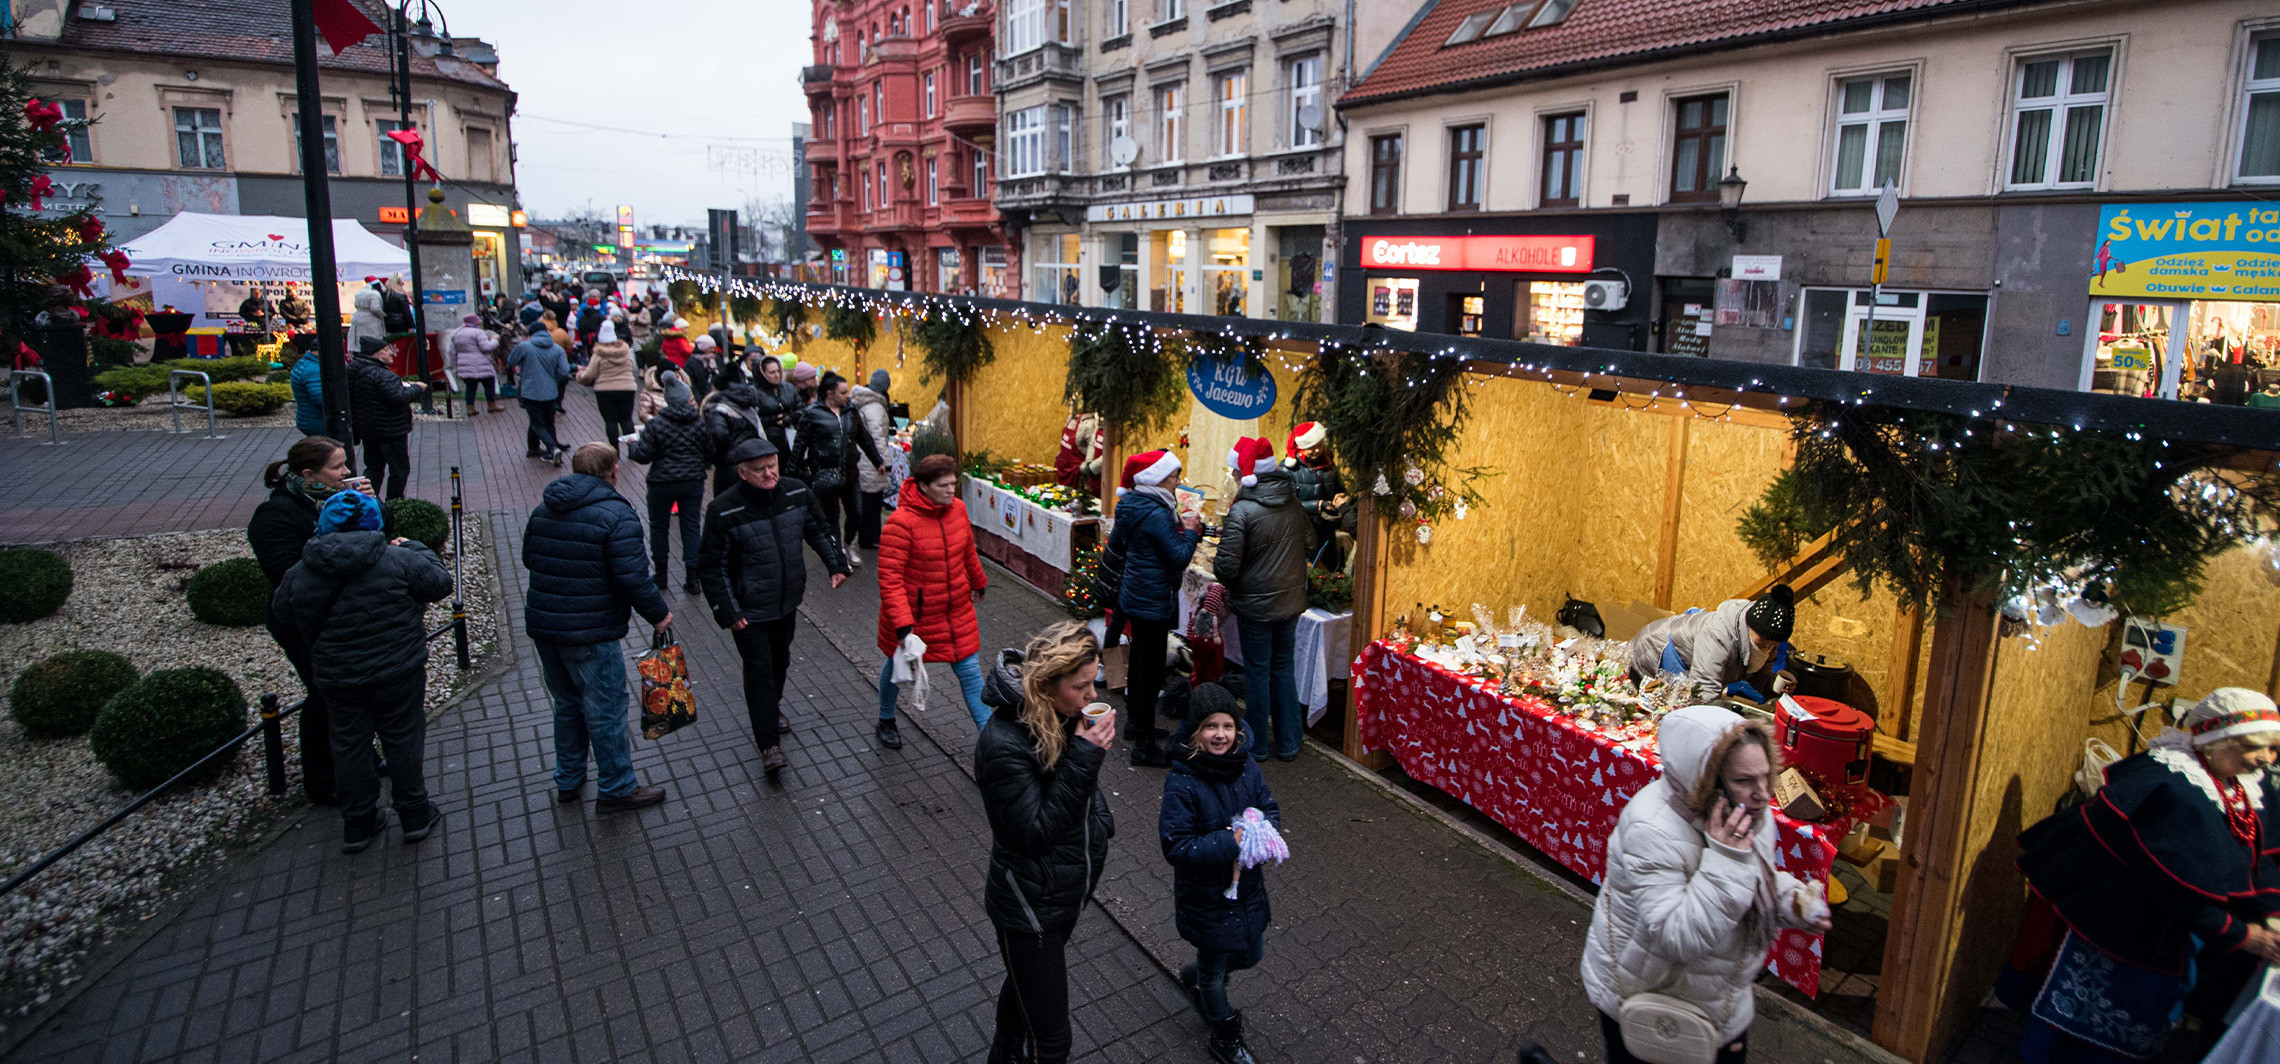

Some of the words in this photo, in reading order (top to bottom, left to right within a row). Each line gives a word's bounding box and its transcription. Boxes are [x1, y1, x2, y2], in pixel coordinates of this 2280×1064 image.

[1106, 199, 1225, 219] GALERIA
[2107, 209, 2242, 241] Świat
[1373, 240, 1440, 264] Cortez
[1496, 247, 1559, 265] ALKOHOLE
[2156, 257, 2205, 267] Odzież
[172, 264, 231, 276] GMINA
[2149, 266, 2208, 276] damska
[2146, 283, 2206, 293] Obuwie
[1876, 359, 1902, 372] 455
[2113, 355, 2146, 369] 50%
[1205, 382, 1253, 408] Jacewo
